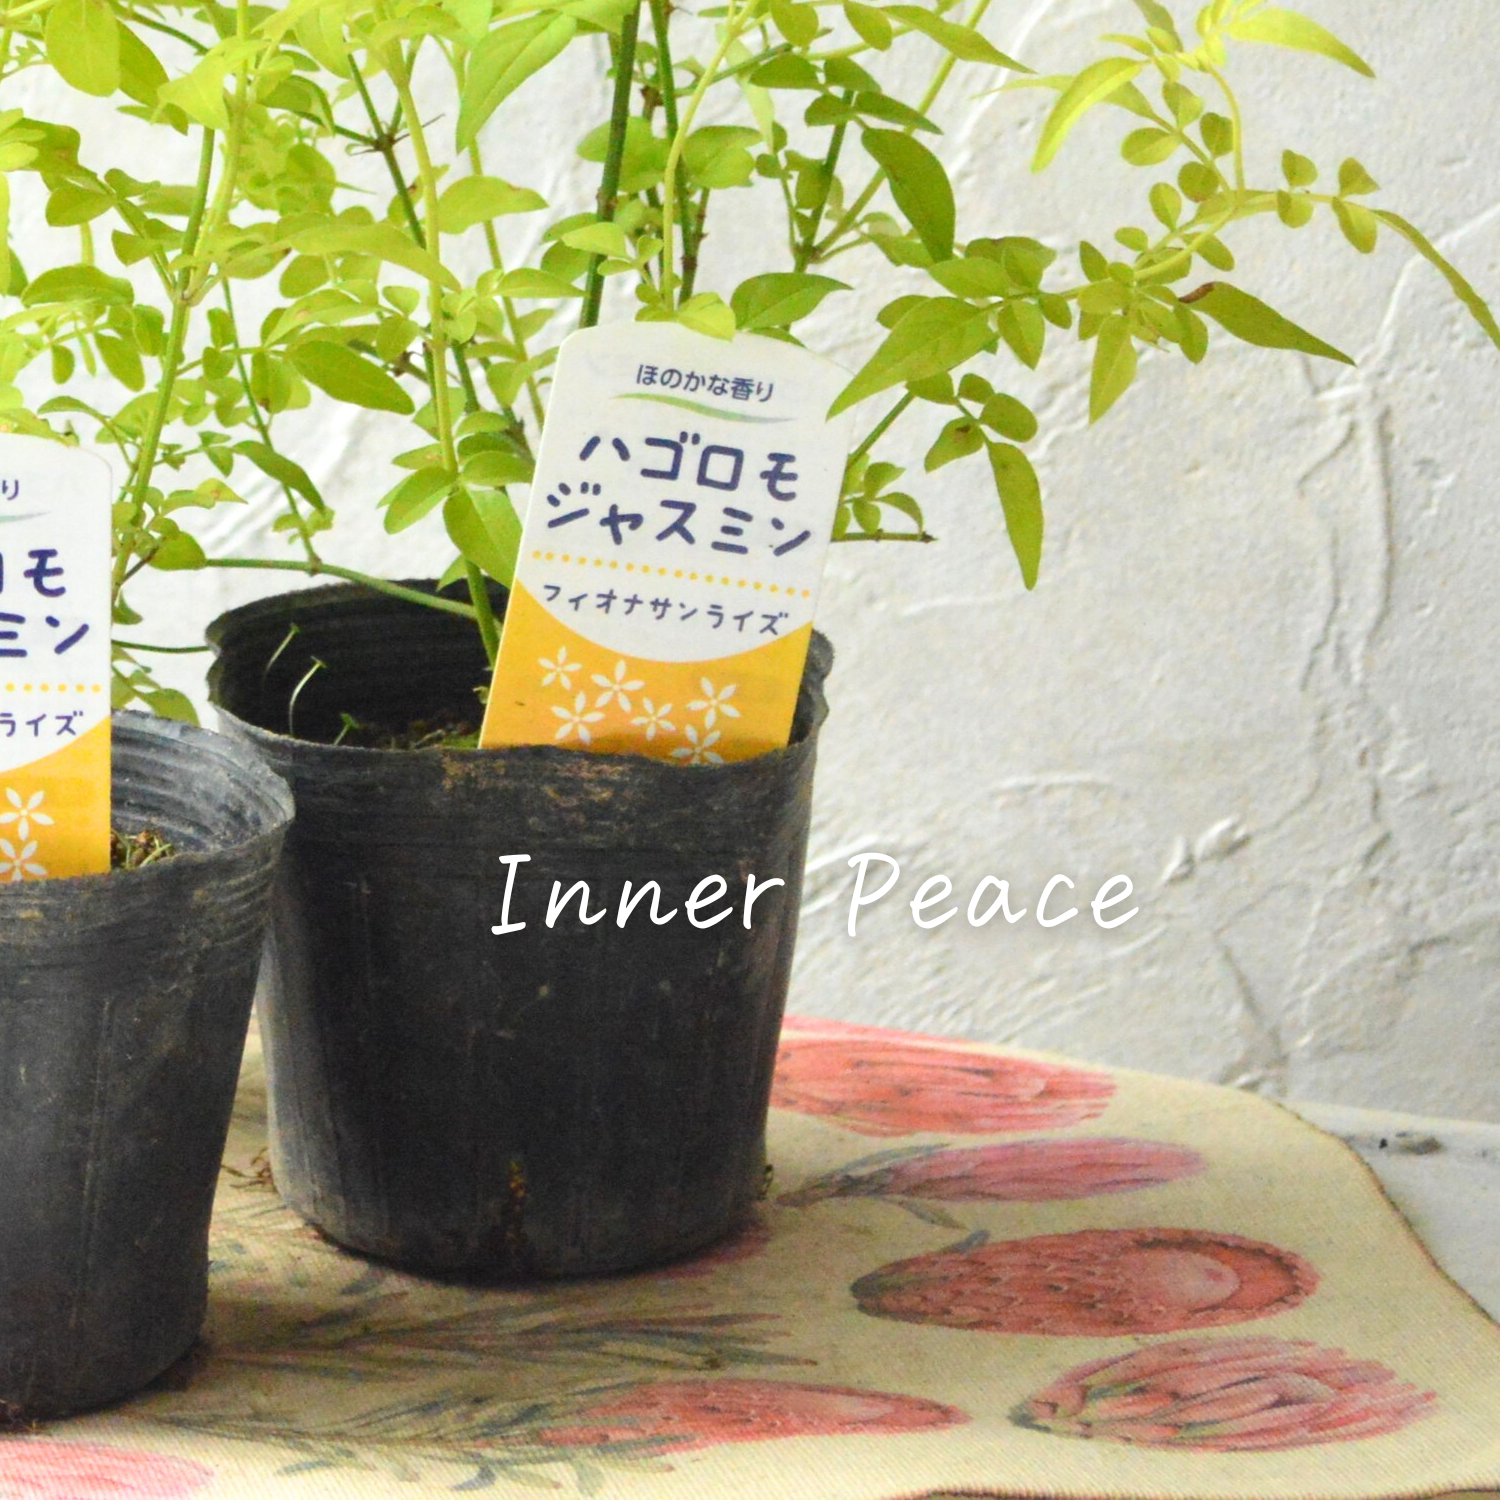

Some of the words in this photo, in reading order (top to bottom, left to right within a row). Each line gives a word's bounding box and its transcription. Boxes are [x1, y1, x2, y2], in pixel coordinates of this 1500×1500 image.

[635, 363, 775, 403] ほのかな香り
[578, 430, 799, 501] ハゴロモ
[546, 481, 812, 558] ジャスミン
[542, 583, 790, 636] フィオナサンライズ
